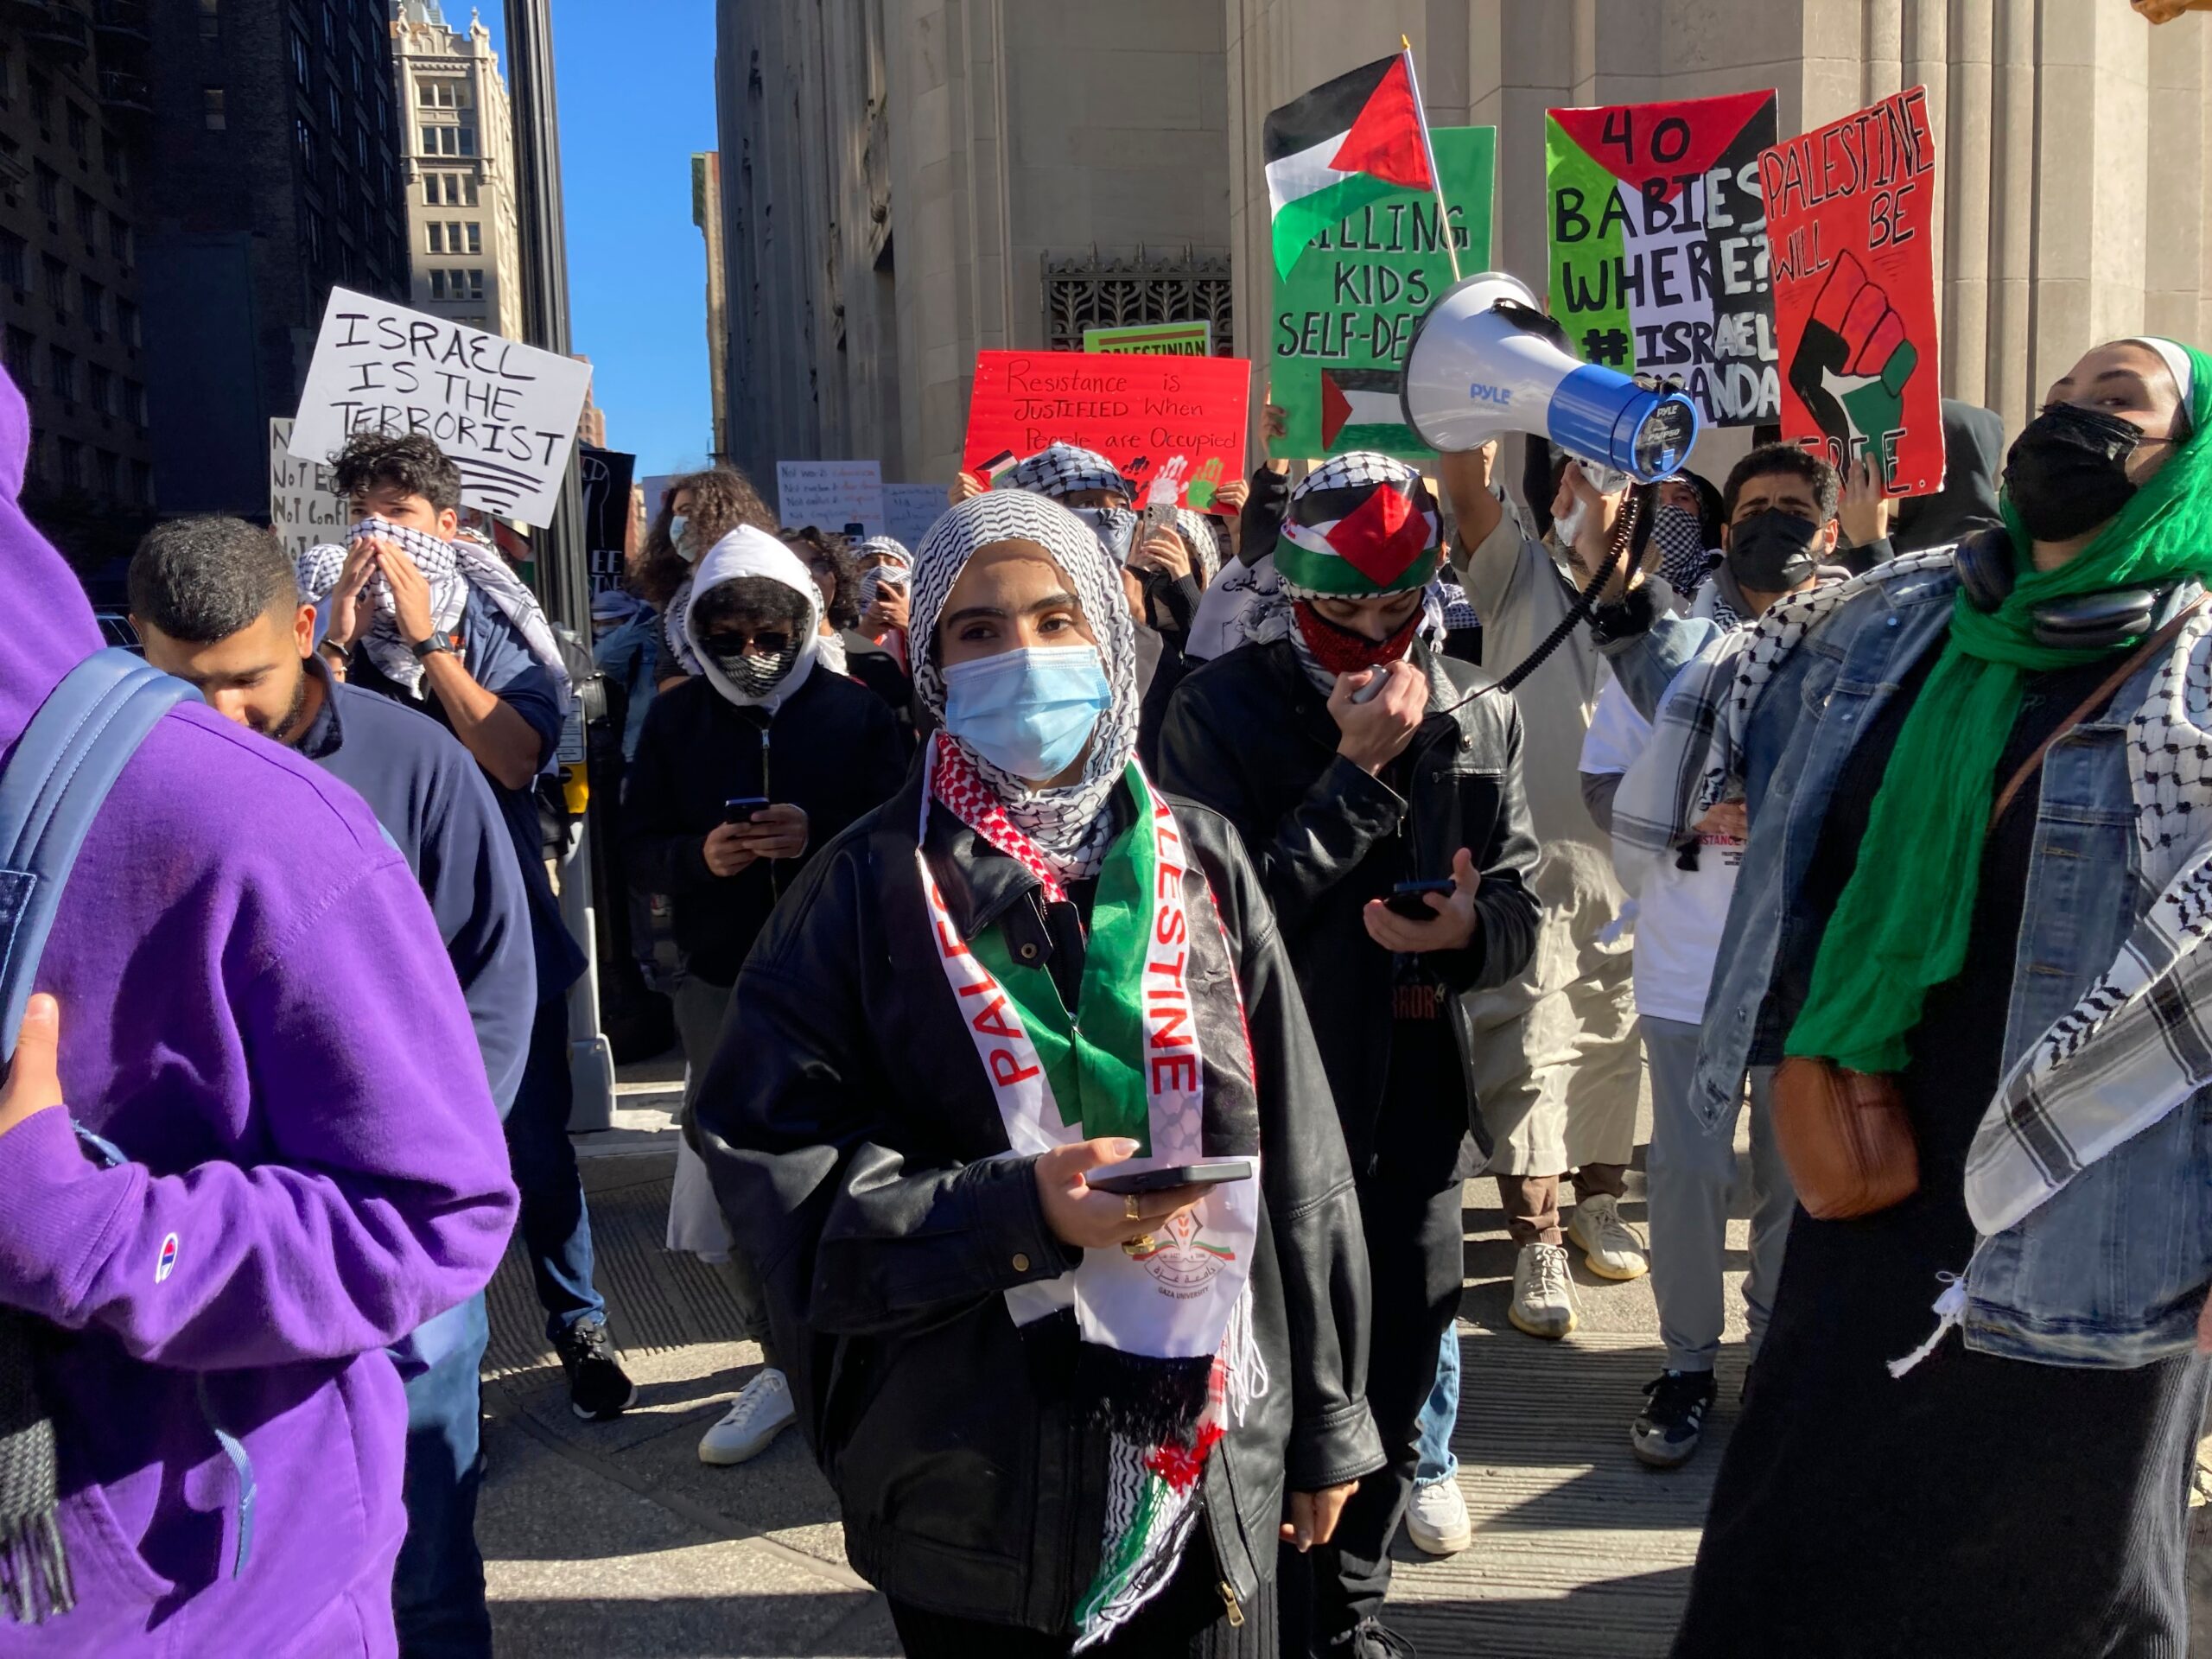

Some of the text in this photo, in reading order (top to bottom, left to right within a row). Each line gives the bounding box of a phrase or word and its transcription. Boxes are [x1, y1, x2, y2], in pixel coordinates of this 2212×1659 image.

[1600, 109, 1691, 165] 40
[1762, 91, 1934, 220] PALESTINE
[1308, 201, 1470, 252] ILLING
[1555, 161, 1765, 243] BABIES
[1769, 184, 1916, 284] WILL BE
[1335, 261, 1431, 307] KIDS
[1561, 234, 1770, 313] WHERE?
[335, 313, 537, 381] ISRAEL
[1277, 311, 1426, 362] SELF-DE
[347, 361, 524, 423] IS THE
[1007, 359, 1180, 393] Resistance is
[1471, 383, 1510, 405] PYLE
[1144, 397, 1203, 416] When
[1656, 404, 1680, 417] PYLE
[329, 401, 565, 466] TERRORIST
[1105, 434, 1141, 448] are
[1150, 427, 1236, 457] Occupied
[1147, 783, 1197, 1095] ALESTINE
[1158, 1285, 1209, 1300] GAZA UNIVERSITY
